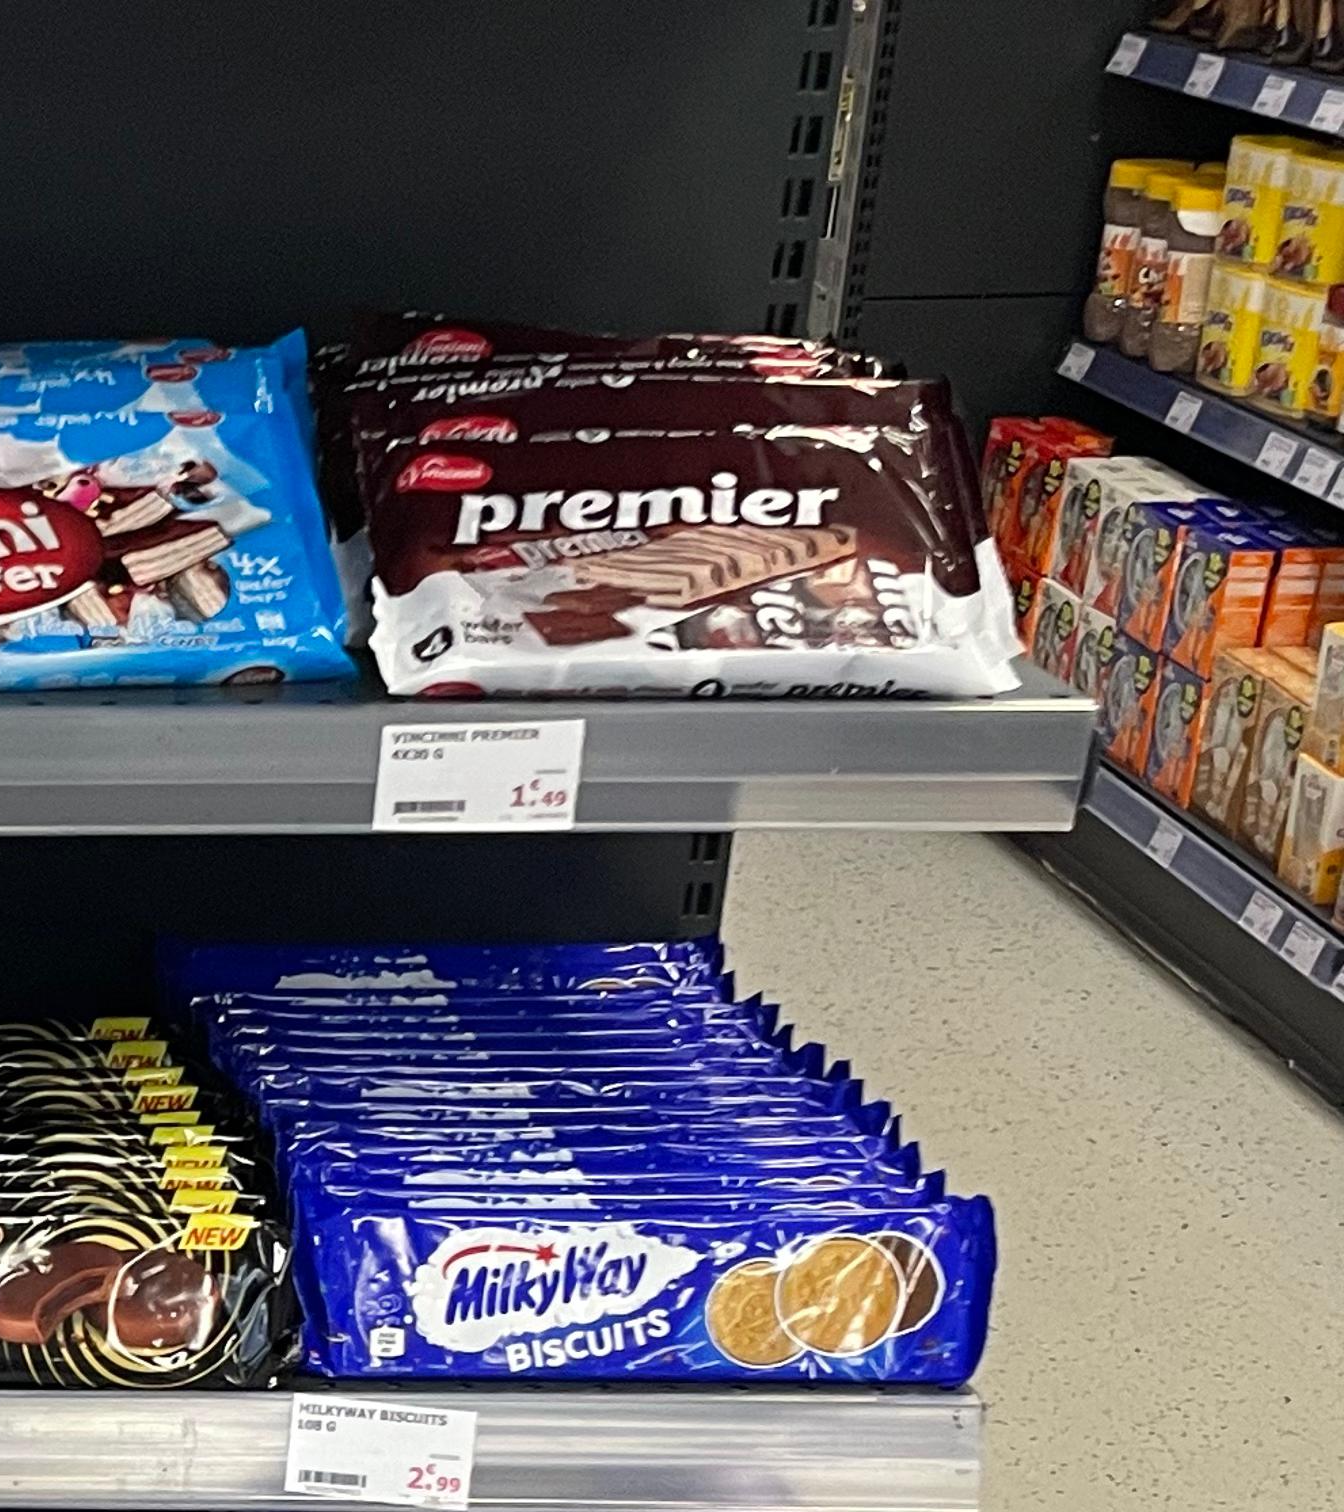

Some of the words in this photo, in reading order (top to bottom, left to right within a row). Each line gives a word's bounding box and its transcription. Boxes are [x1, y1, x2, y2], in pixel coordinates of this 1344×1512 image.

[453, 472, 840, 545] premier
[185, 1224, 247, 1248] NEW
[505, 1310, 672, 1373] BISCUITS
[299, 1403, 377, 1420] MILKYWAY
[380, 1410, 448, 1426] BISCUITS
